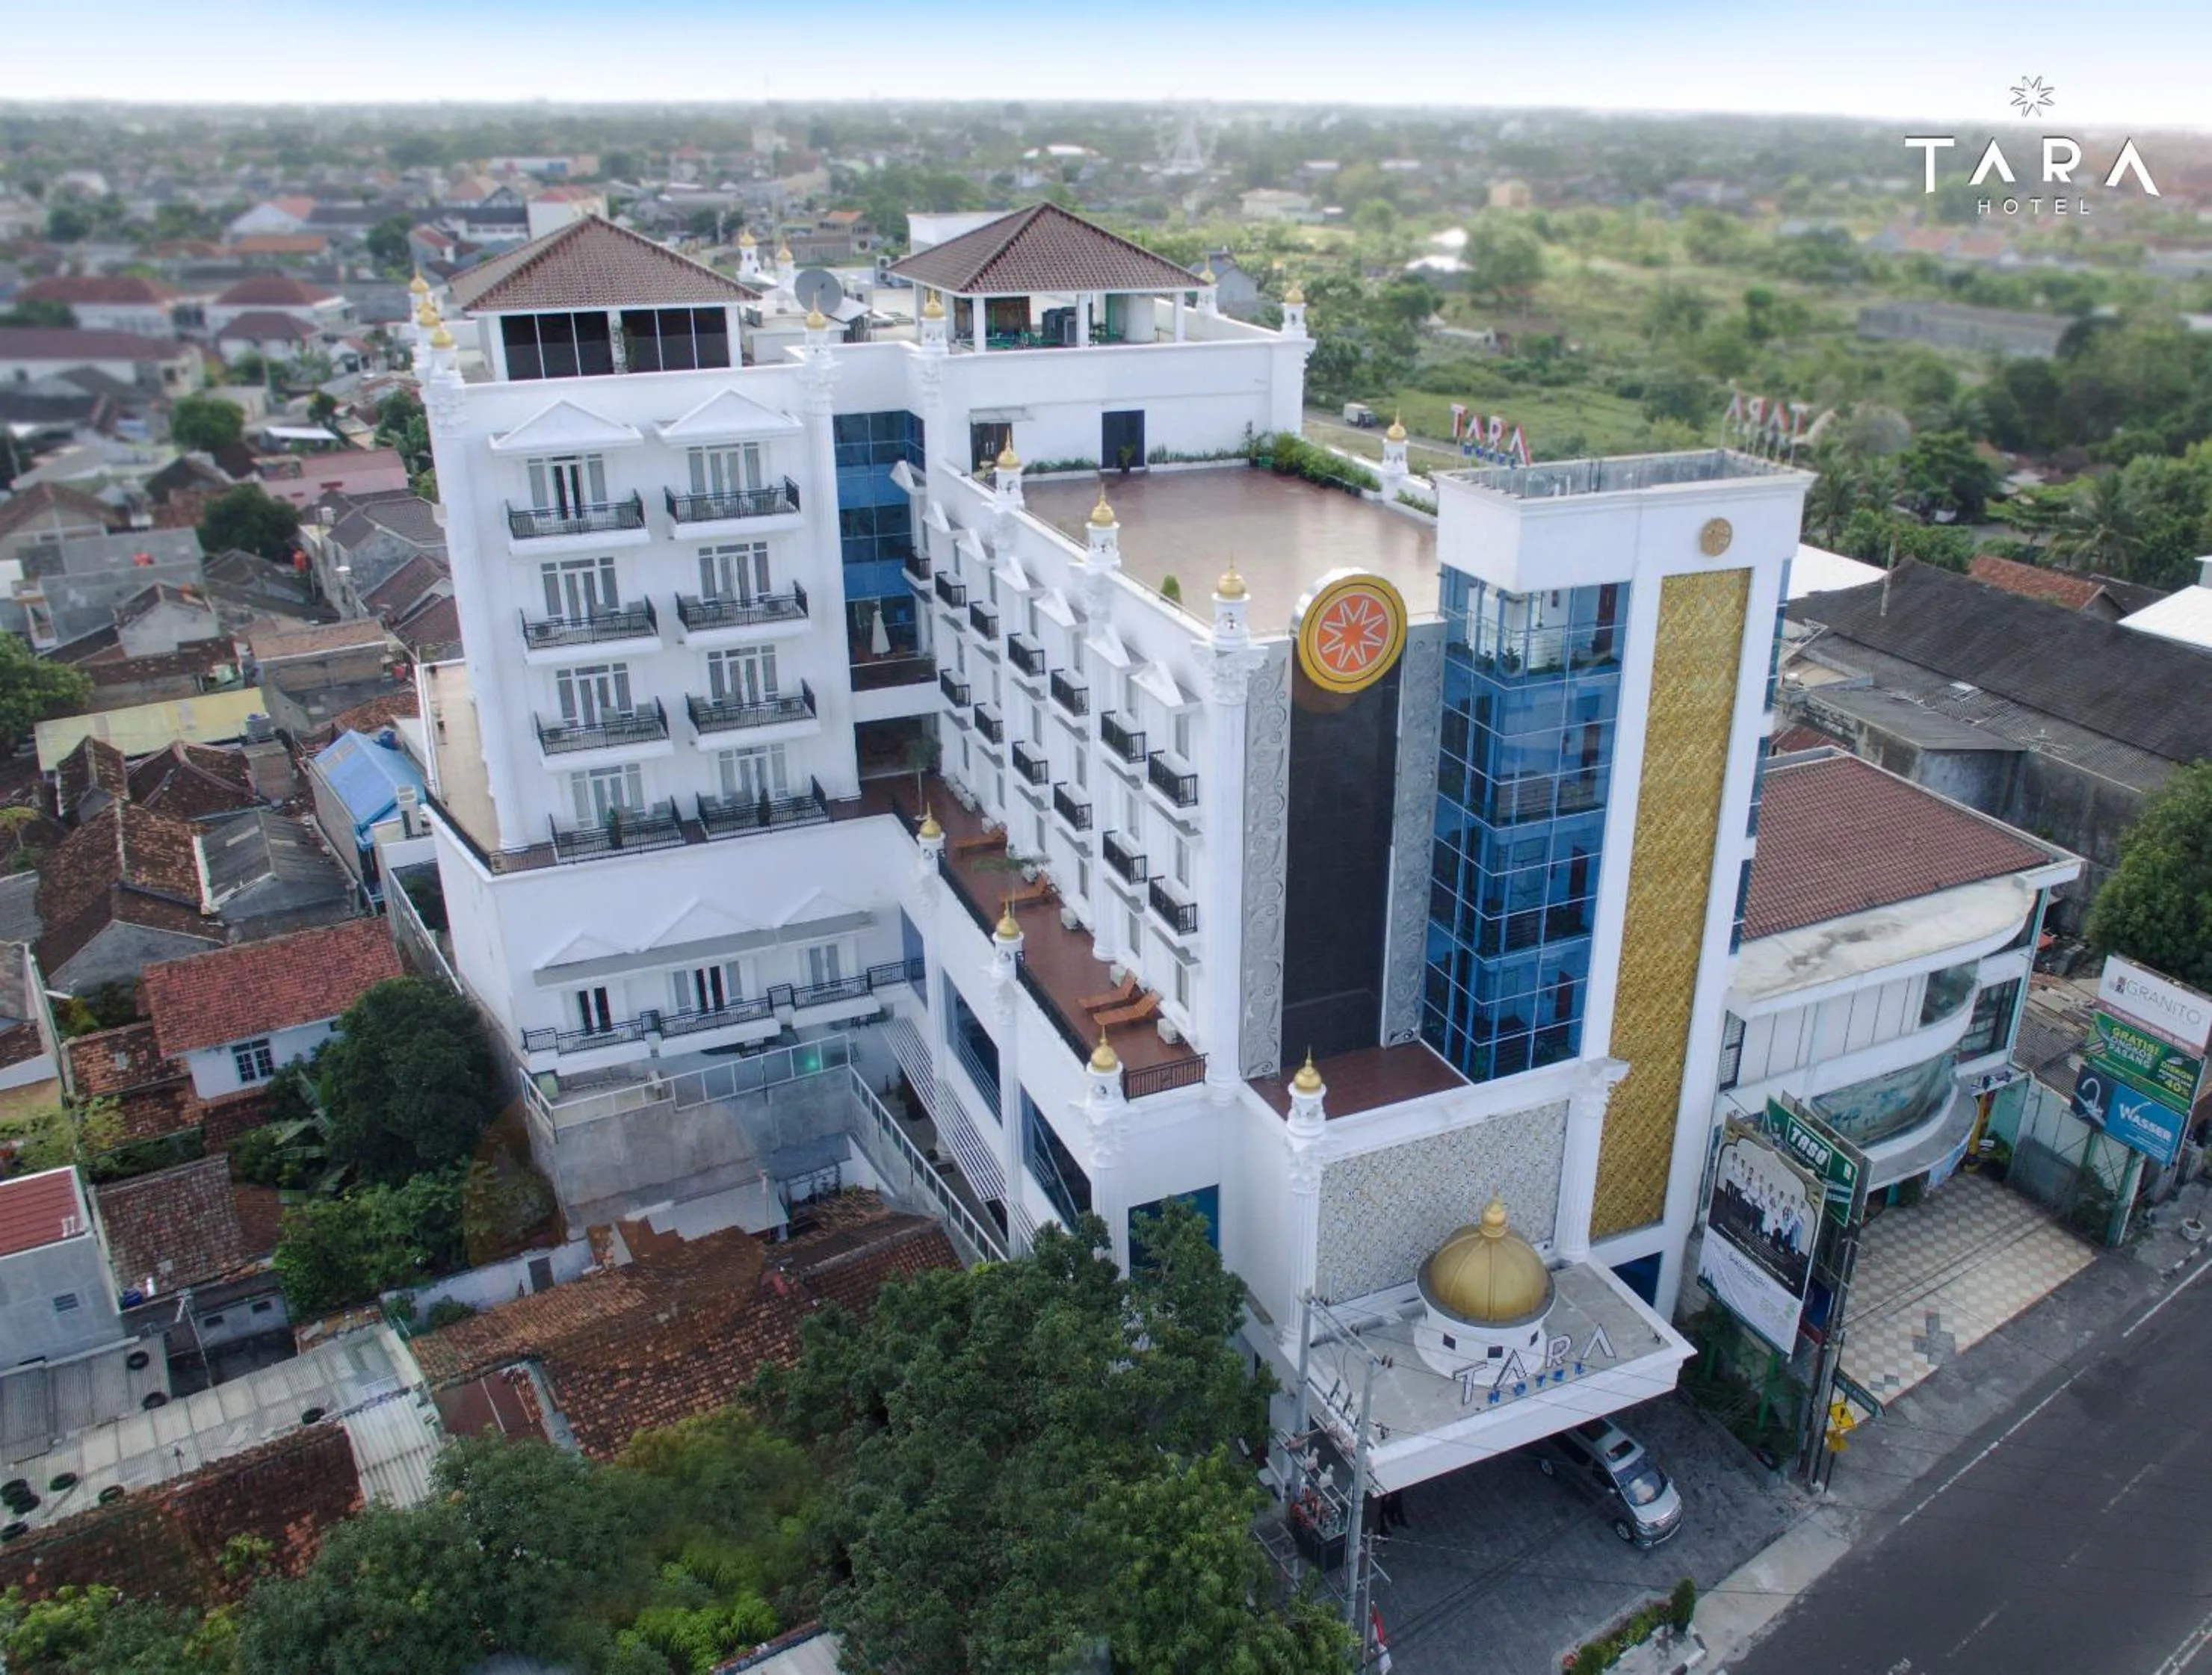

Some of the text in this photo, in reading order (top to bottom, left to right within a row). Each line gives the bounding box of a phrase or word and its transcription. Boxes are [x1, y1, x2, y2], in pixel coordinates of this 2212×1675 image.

[1451, 402, 1531, 466] TARA
[2125, 979, 2202, 1026] GRANITO
[1452, 1322, 1617, 1406] TARA
[1487, 1361, 1584, 1405] HOTEL
